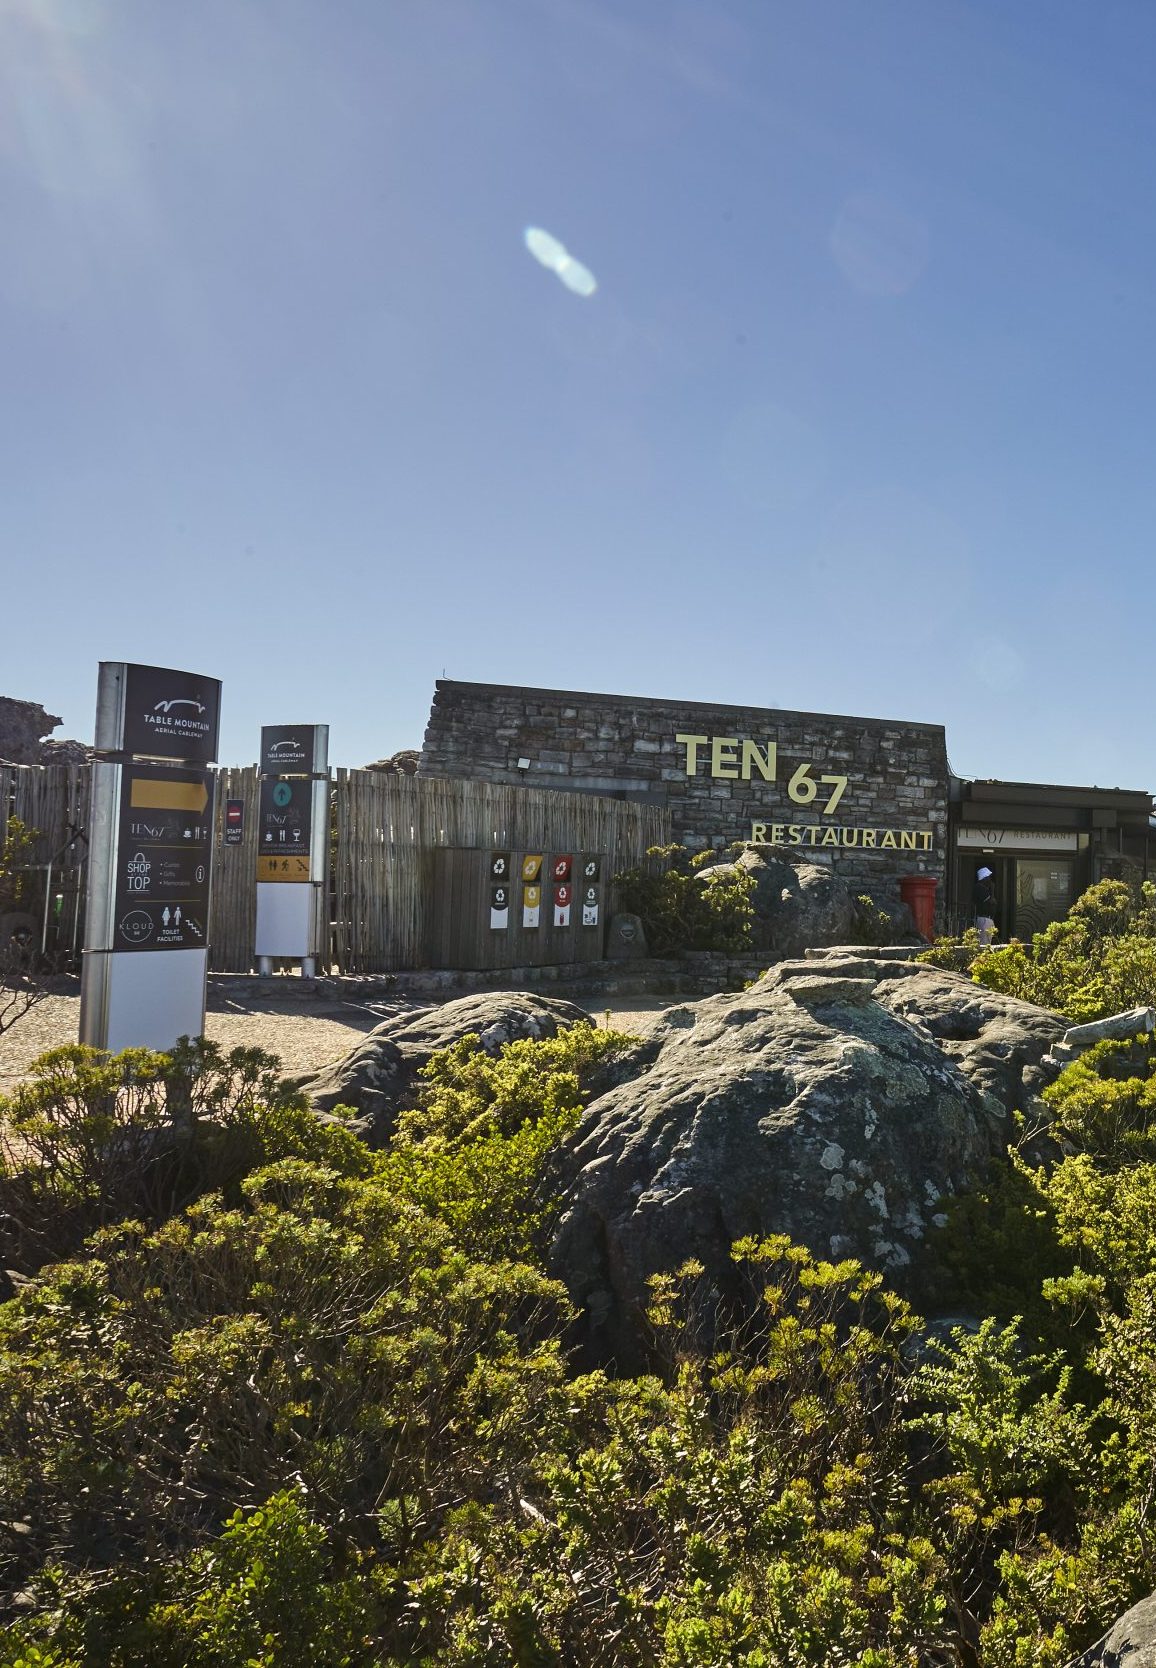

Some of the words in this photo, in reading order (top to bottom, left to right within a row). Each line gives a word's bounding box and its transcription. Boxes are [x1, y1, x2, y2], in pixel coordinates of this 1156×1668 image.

[143, 714, 173, 725] TABLE
[174, 719, 210, 731] MOUNTAIN
[154, 727, 177, 735] AERIAL
[675, 733, 777, 781] TEN
[787, 763, 848, 814] 67
[751, 823, 933, 851] RESTAURANT
[1014, 831, 1072, 840] RESTAURANT
[127, 863, 151, 873] SHOP
[127, 876, 151, 890] TOP
[119, 922, 154, 930] KLOUD
